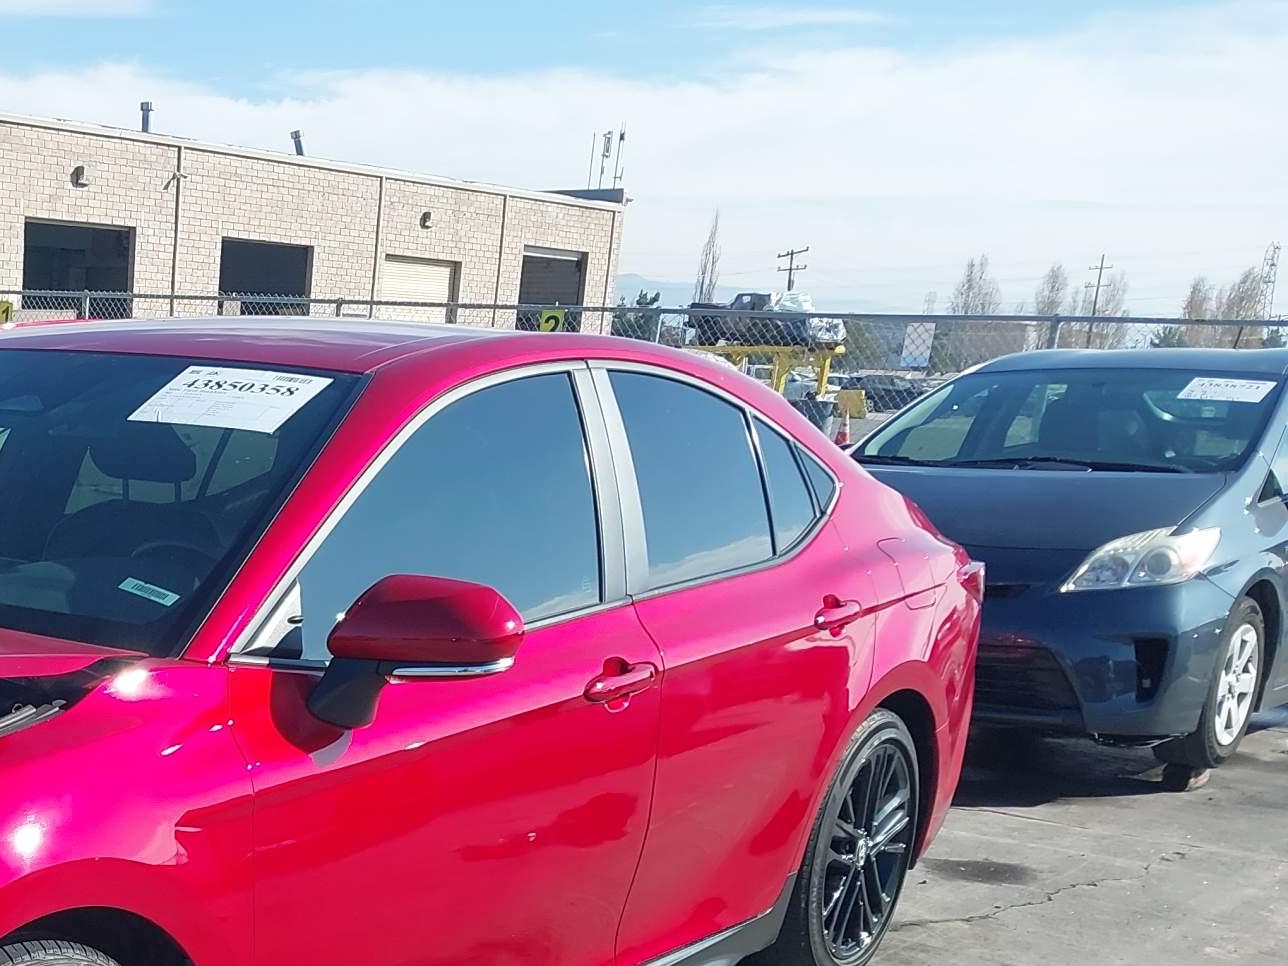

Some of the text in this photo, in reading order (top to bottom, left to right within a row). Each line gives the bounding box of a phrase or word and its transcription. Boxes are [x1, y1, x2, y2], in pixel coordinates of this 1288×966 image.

[1, 306, 10, 324] 1
[544, 315, 560, 332] 2
[182, 378, 300, 397] 43850358
